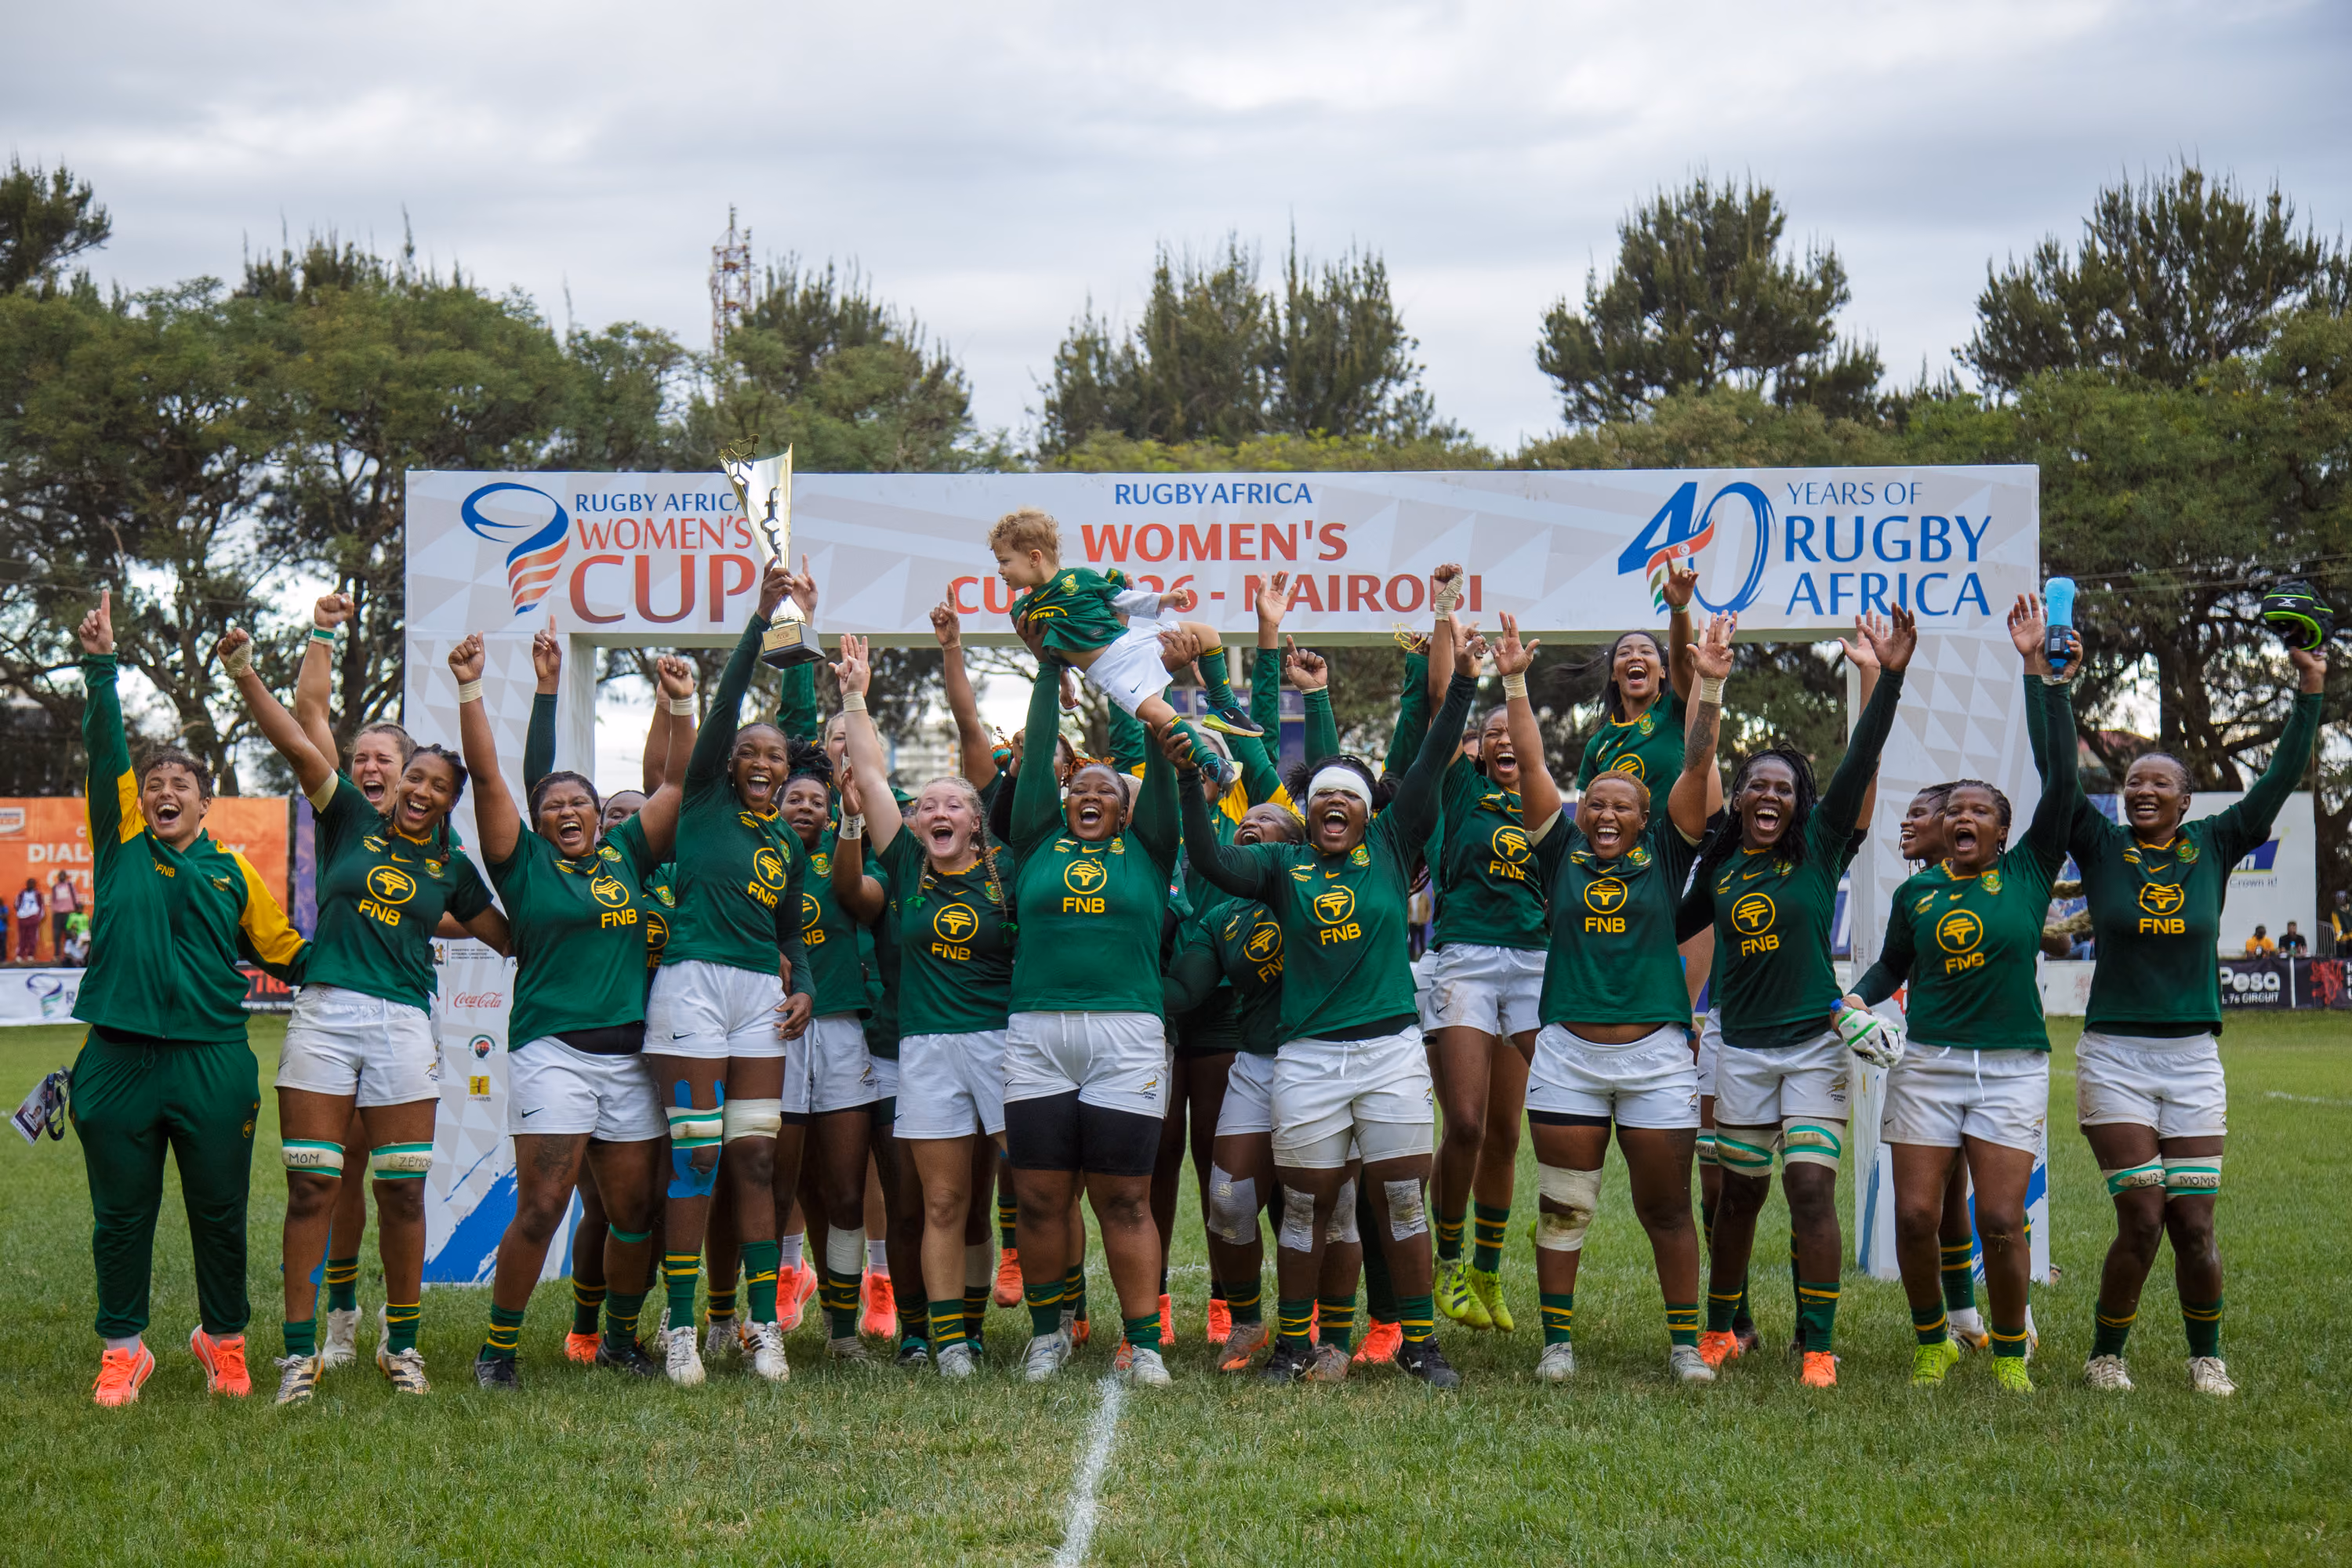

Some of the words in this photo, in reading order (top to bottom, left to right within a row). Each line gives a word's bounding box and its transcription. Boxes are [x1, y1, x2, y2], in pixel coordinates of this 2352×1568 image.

[575, 493, 658, 512] RUGBY
[1115, 483, 1208, 506] RUGBY
[1210, 482, 1313, 505] AFRICA
[1787, 481, 1875, 506] YEARS
[1884, 481, 1923, 506] OF
[1081, 521, 1348, 563] WOMEN'S
[1784, 514, 1993, 563] RUGBY
[568, 554, 757, 624] CUP
[1785, 571, 1991, 617] AFRICA
[155, 864, 176, 878] FNB
[358, 898, 401, 926] FNB
[1063, 897, 1105, 913] FNB
[601, 908, 638, 928] FNB
[1584, 916, 1626, 933] FNB
[2139, 918, 2186, 935] FNB
[803, 929, 826, 946] NB
[1320, 923, 1362, 946] FNB
[1741, 934, 1780, 956] FNB
[931, 942, 971, 960] FNB
[1257, 953, 1284, 983] FN
[1945, 952, 1985, 975] FNB
[2241, 992, 2279, 1004] CIRCUIT
[289, 1152, 320, 1164] MOM
